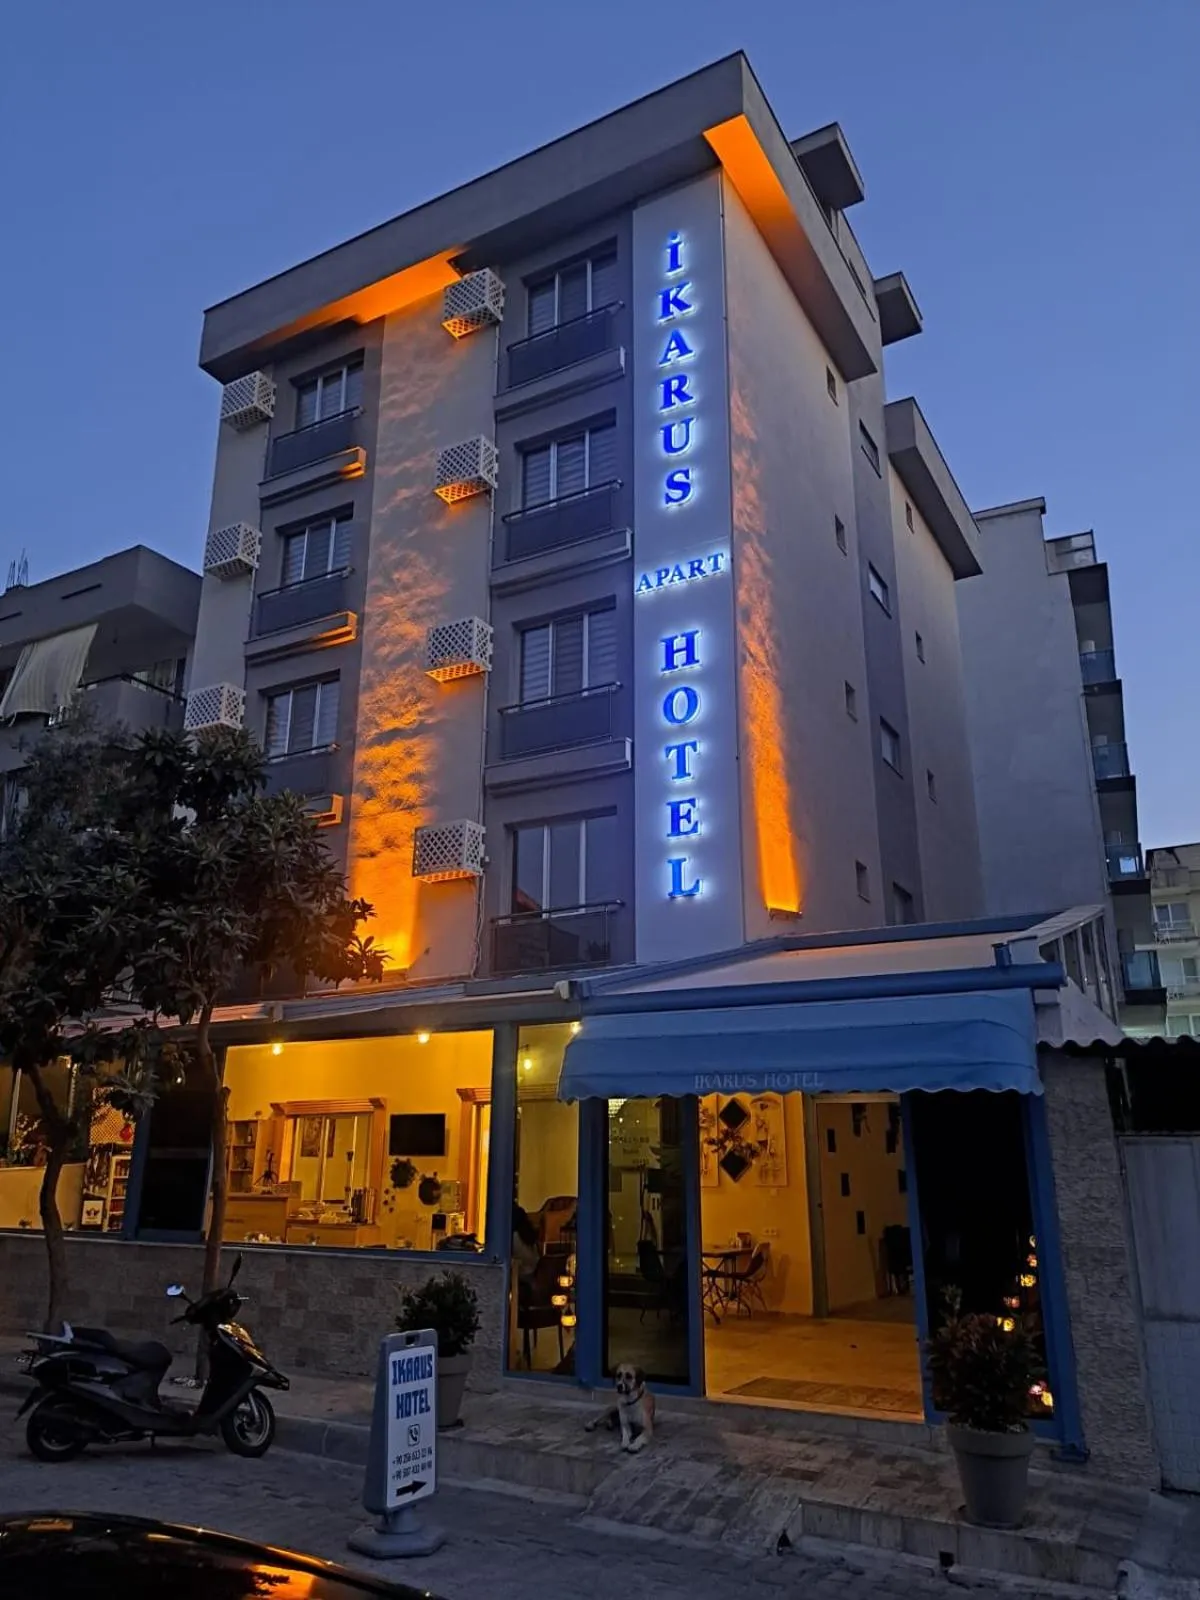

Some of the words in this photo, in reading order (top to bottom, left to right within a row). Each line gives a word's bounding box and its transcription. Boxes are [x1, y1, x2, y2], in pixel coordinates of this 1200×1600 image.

[635, 552, 725, 593] APART
[659, 629, 701, 898] HOTEL
[694, 1073, 757, 1089] IKARUS
[764, 1072, 824, 1088] HOTEL
[392, 1354, 433, 1385] IKARUS
[396, 1388, 431, 1420] HOTEL
